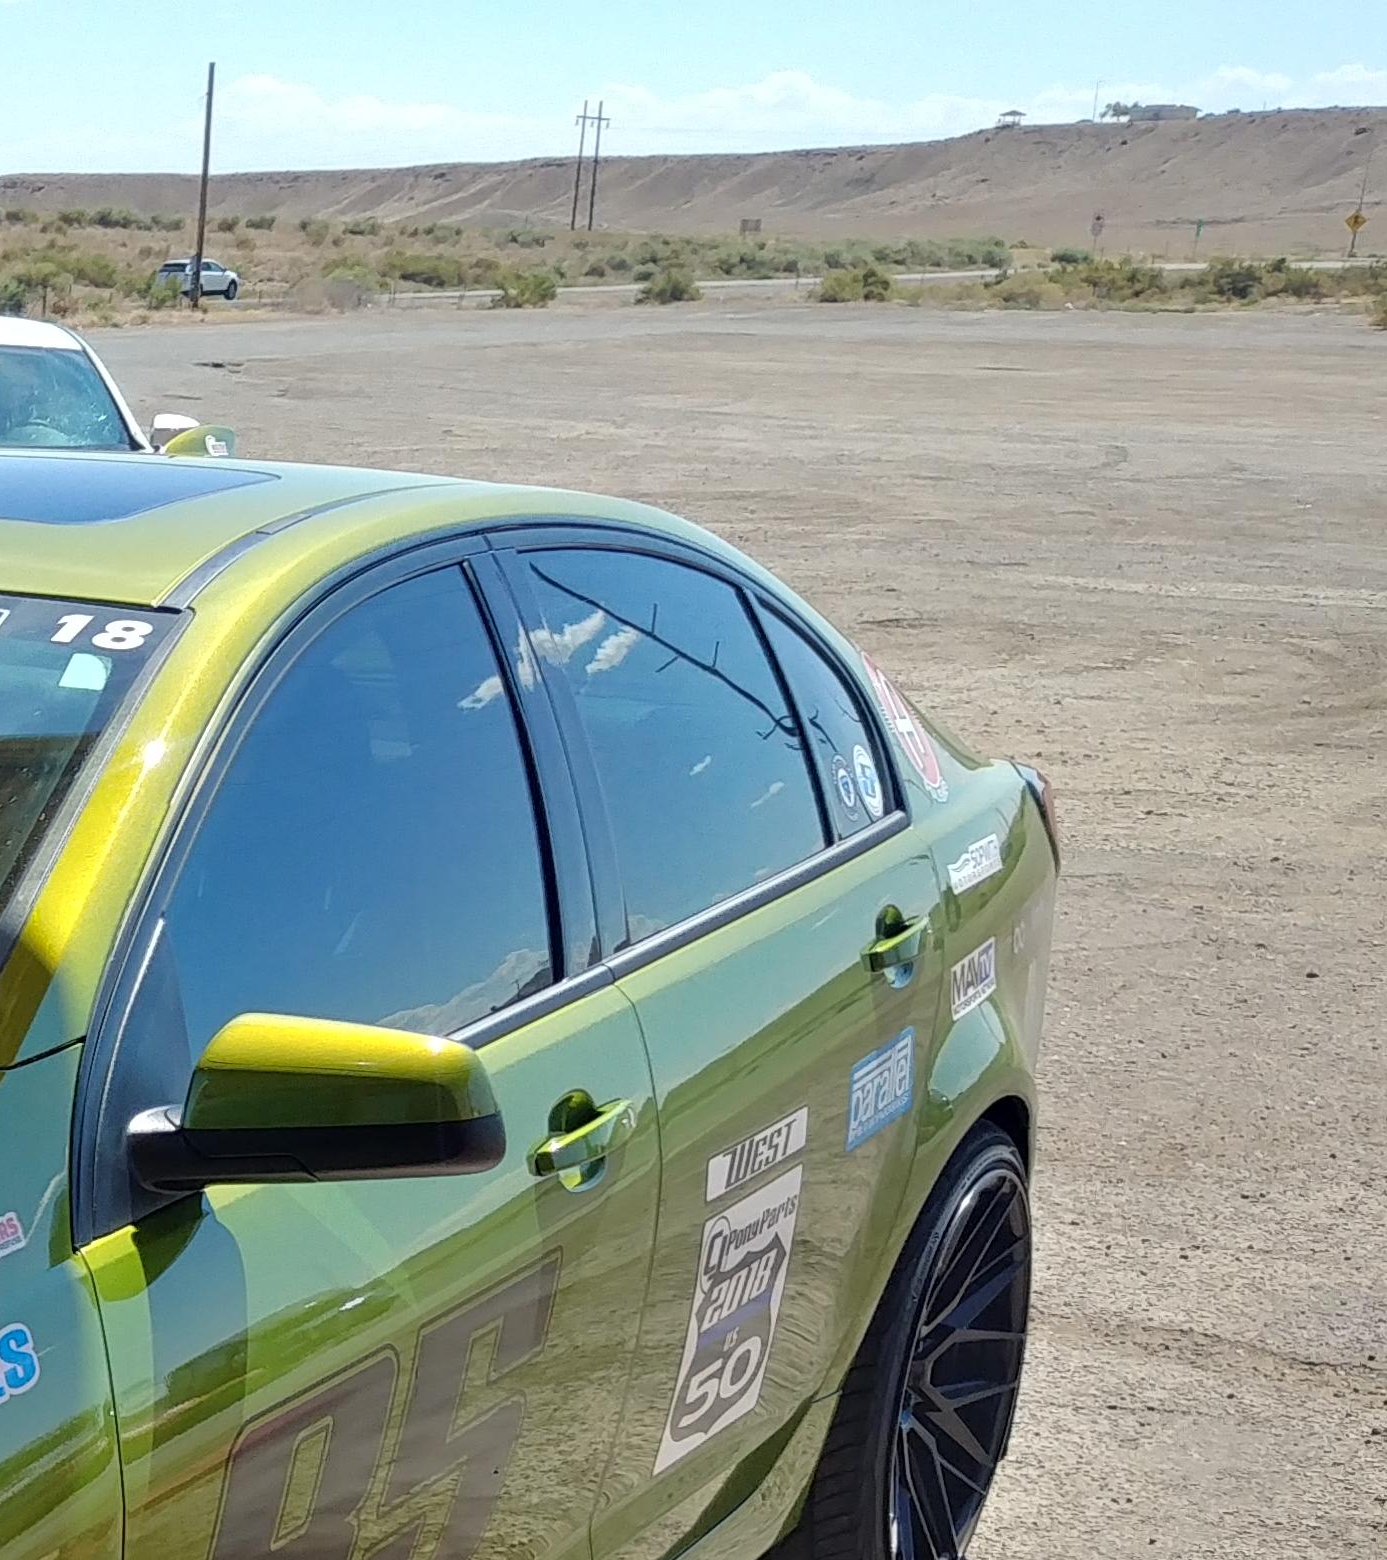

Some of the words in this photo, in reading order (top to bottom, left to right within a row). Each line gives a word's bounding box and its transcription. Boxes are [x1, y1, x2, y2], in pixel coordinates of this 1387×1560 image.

[50, 614, 154, 650] 18
[723, 1118, 797, 1190] WEST
[699, 1248, 779, 1334] 2018
[723, 1326, 740, 1353] US
[678, 1335, 763, 1429] 50
